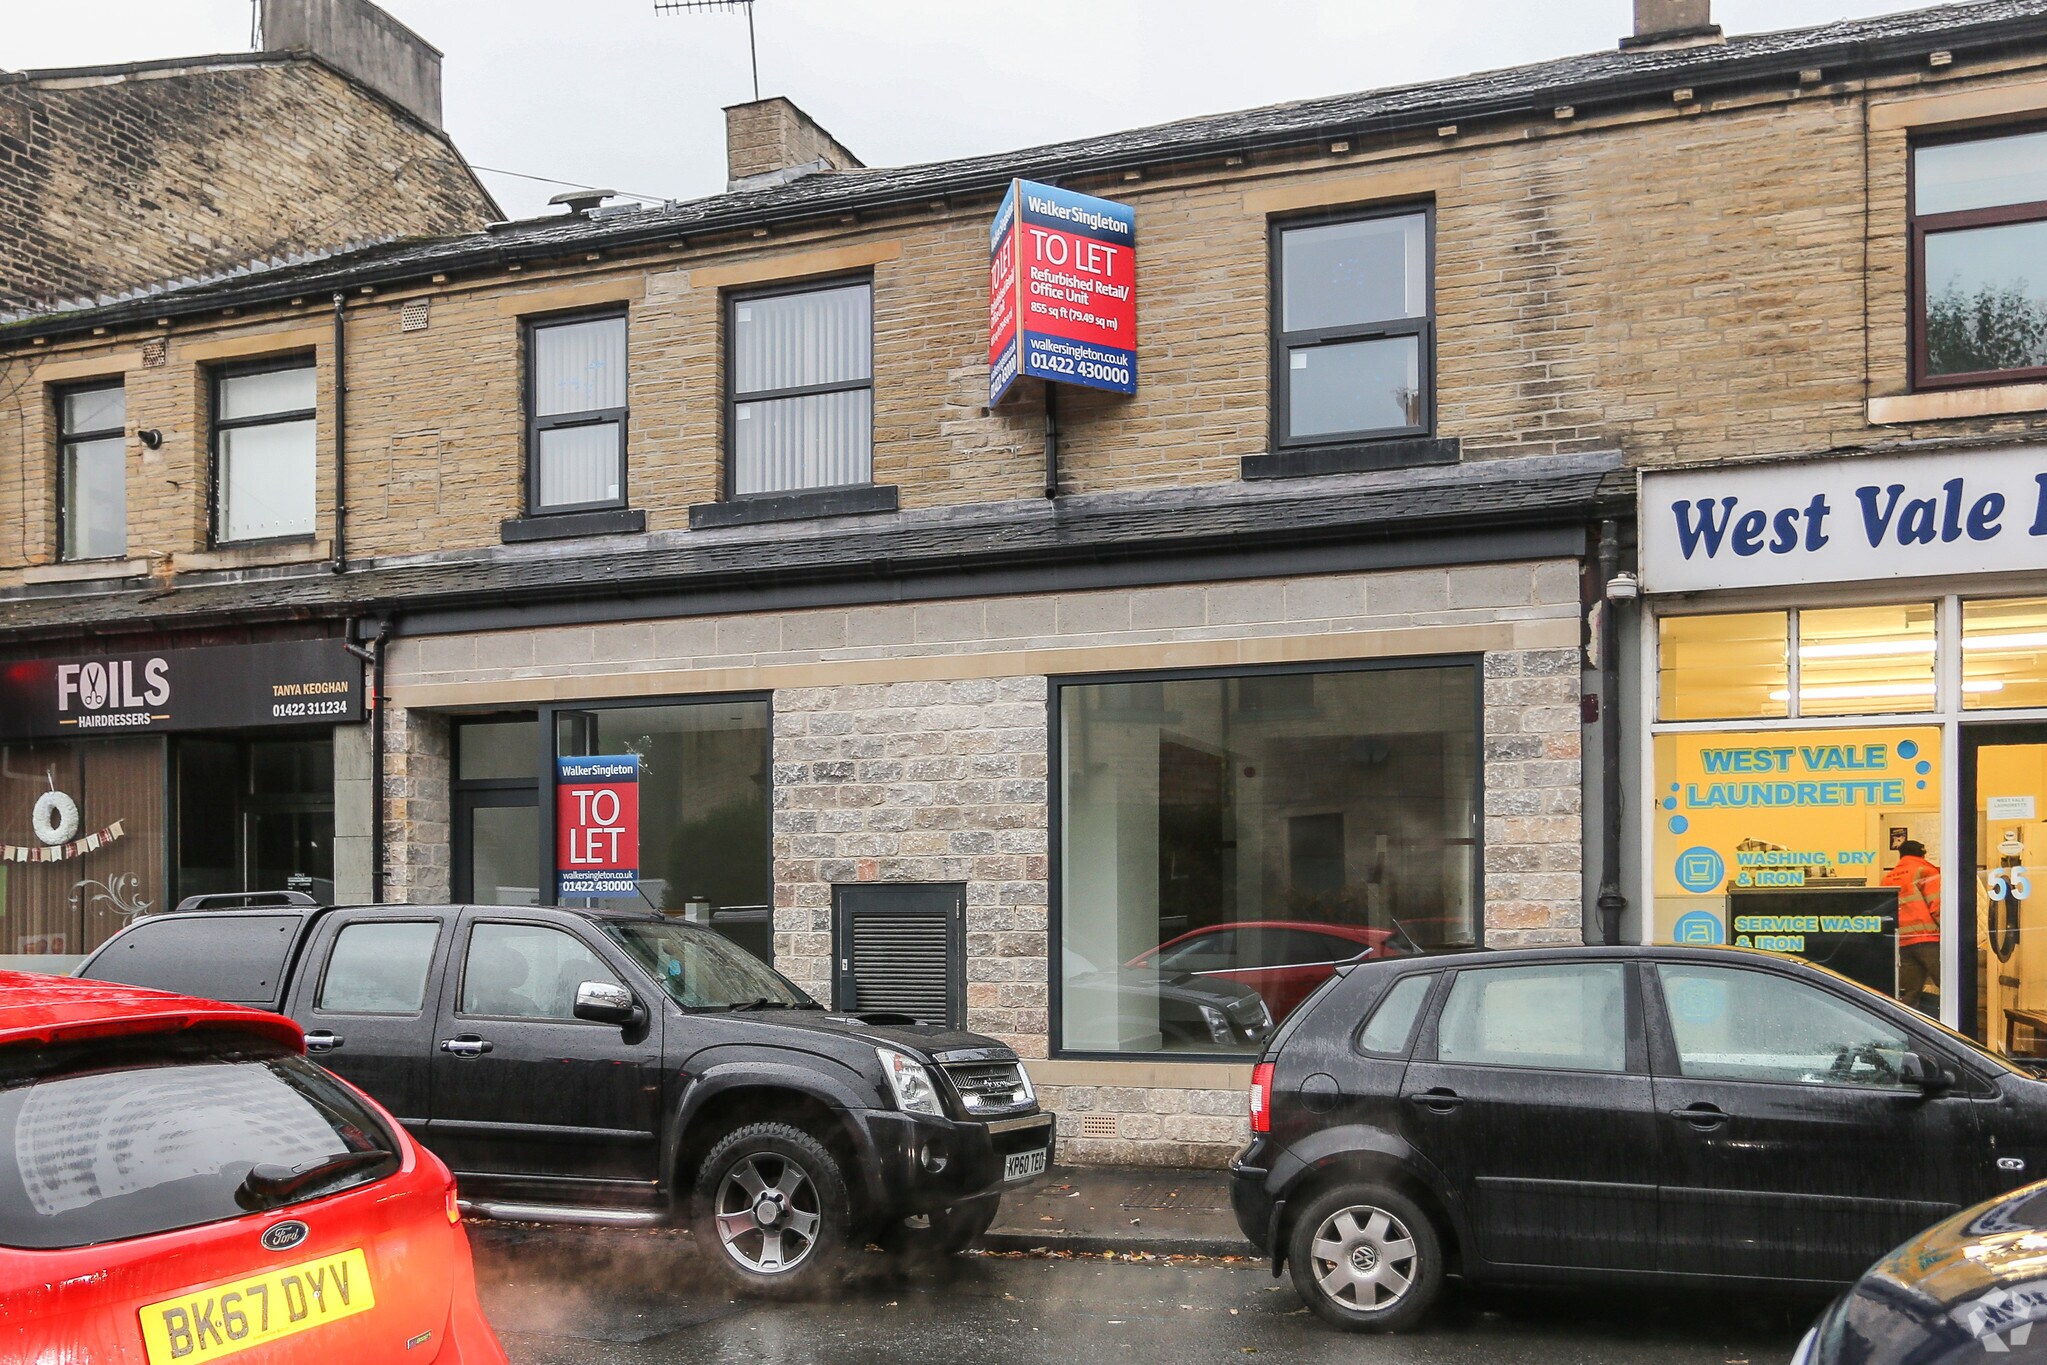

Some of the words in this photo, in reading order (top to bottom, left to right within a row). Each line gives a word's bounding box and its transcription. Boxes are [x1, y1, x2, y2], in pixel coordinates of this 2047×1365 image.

[999, 235, 1012, 279] LET
[1030, 229, 1068, 265] TO
[1075, 239, 1118, 277] LET
[1030, 267, 1094, 292] Refurbished
[1095, 280, 1129, 302] Retail/
[1030, 281, 1064, 301] Office
[1066, 289, 1089, 306] Unit
[1030, 301, 1047, 315] 855
[1047, 307, 1059, 319] sq
[1059, 306, 1068, 319] ft
[1069, 308, 1095, 324] (79.49
[1095, 316, 1107, 329] sq
[1107, 317, 1118, 331] m)
[1030, 339, 1128, 366] walkersingleton.co.uk
[1030, 352, 1075, 376] 01422
[1077, 360, 1129, 385] 430000
[1671, 492, 1831, 561] West
[1855, 477, 2006, 549] Vale
[58, 657, 171, 712] FOILS
[272, 684, 302, 697] TANYA
[303, 681, 348, 695] KEOGHAN
[78, 713, 151, 728] HAIRDRESSERS
[272, 703, 306, 717] 01422
[307, 700, 347, 715] 311234
[1700, 746, 1796, 774] WEST
[1800, 743, 1888, 771] VALE
[571, 789, 621, 826] TO
[1685, 778, 1905, 809] LAUNDRETTE
[570, 827, 626, 864] LET
[1736, 850, 1833, 867] WASHING,
[1836, 850, 1877, 865] DRY
[562, 881, 595, 892] 01422
[595, 880, 634, 892] 430000
[563, 870, 633, 881] walkersingleton.co.uk
[1736, 872, 1751, 887] &
[1754, 871, 1805, 886] IRON
[1988, 865, 2032, 901] 55
[1734, 915, 1819, 932] SERVICE
[1820, 915, 1881, 932] WASH
[1735, 935, 1753, 948] &
[1754, 935, 1805, 952] IRON
[1008, 1155, 1030, 1177] KP60
[272, 1226, 299, 1245] Ford
[162, 1283, 269, 1359] BK67
[280, 1260, 351, 1323] DYV
